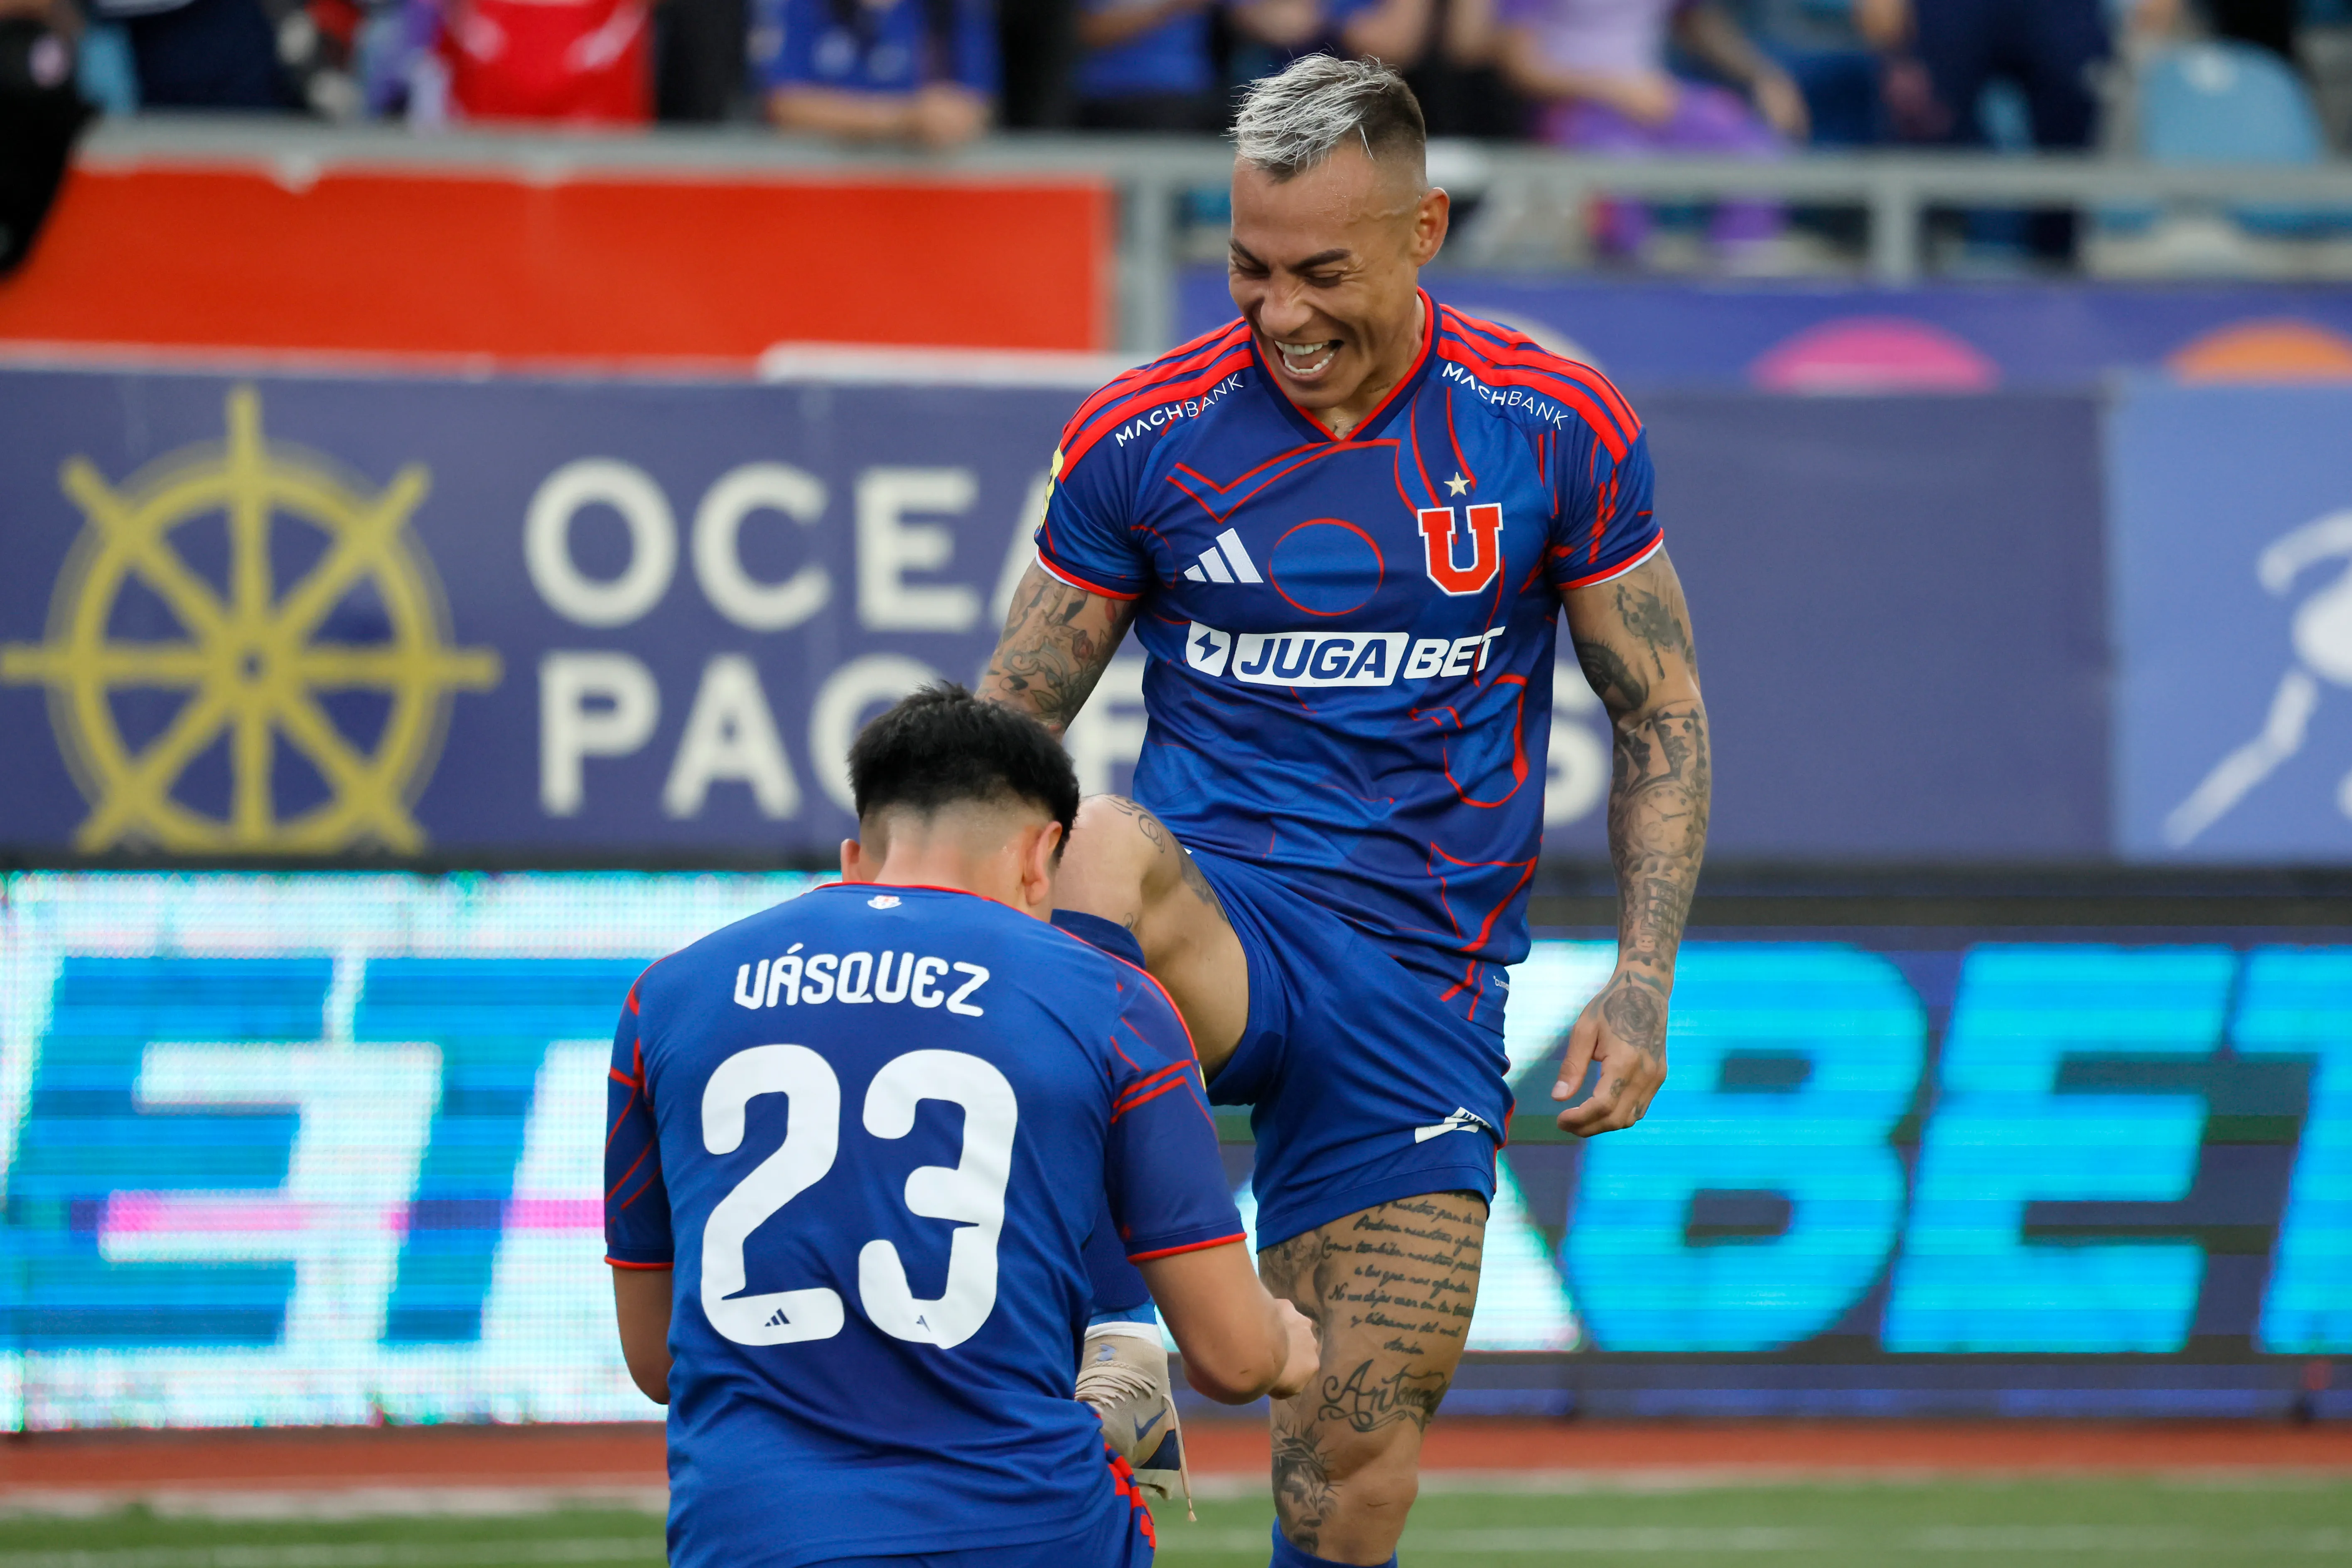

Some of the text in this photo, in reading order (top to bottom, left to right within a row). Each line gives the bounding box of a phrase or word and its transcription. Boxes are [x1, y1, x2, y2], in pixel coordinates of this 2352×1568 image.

[1116, 374, 1244, 447] MACHBANK
[1442, 362, 1568, 430] MACHBANK
[1418, 503, 1503, 597] U
[734, 942, 990, 1017] VÁSQUEZ
[701, 1044, 1018, 1349] 23
